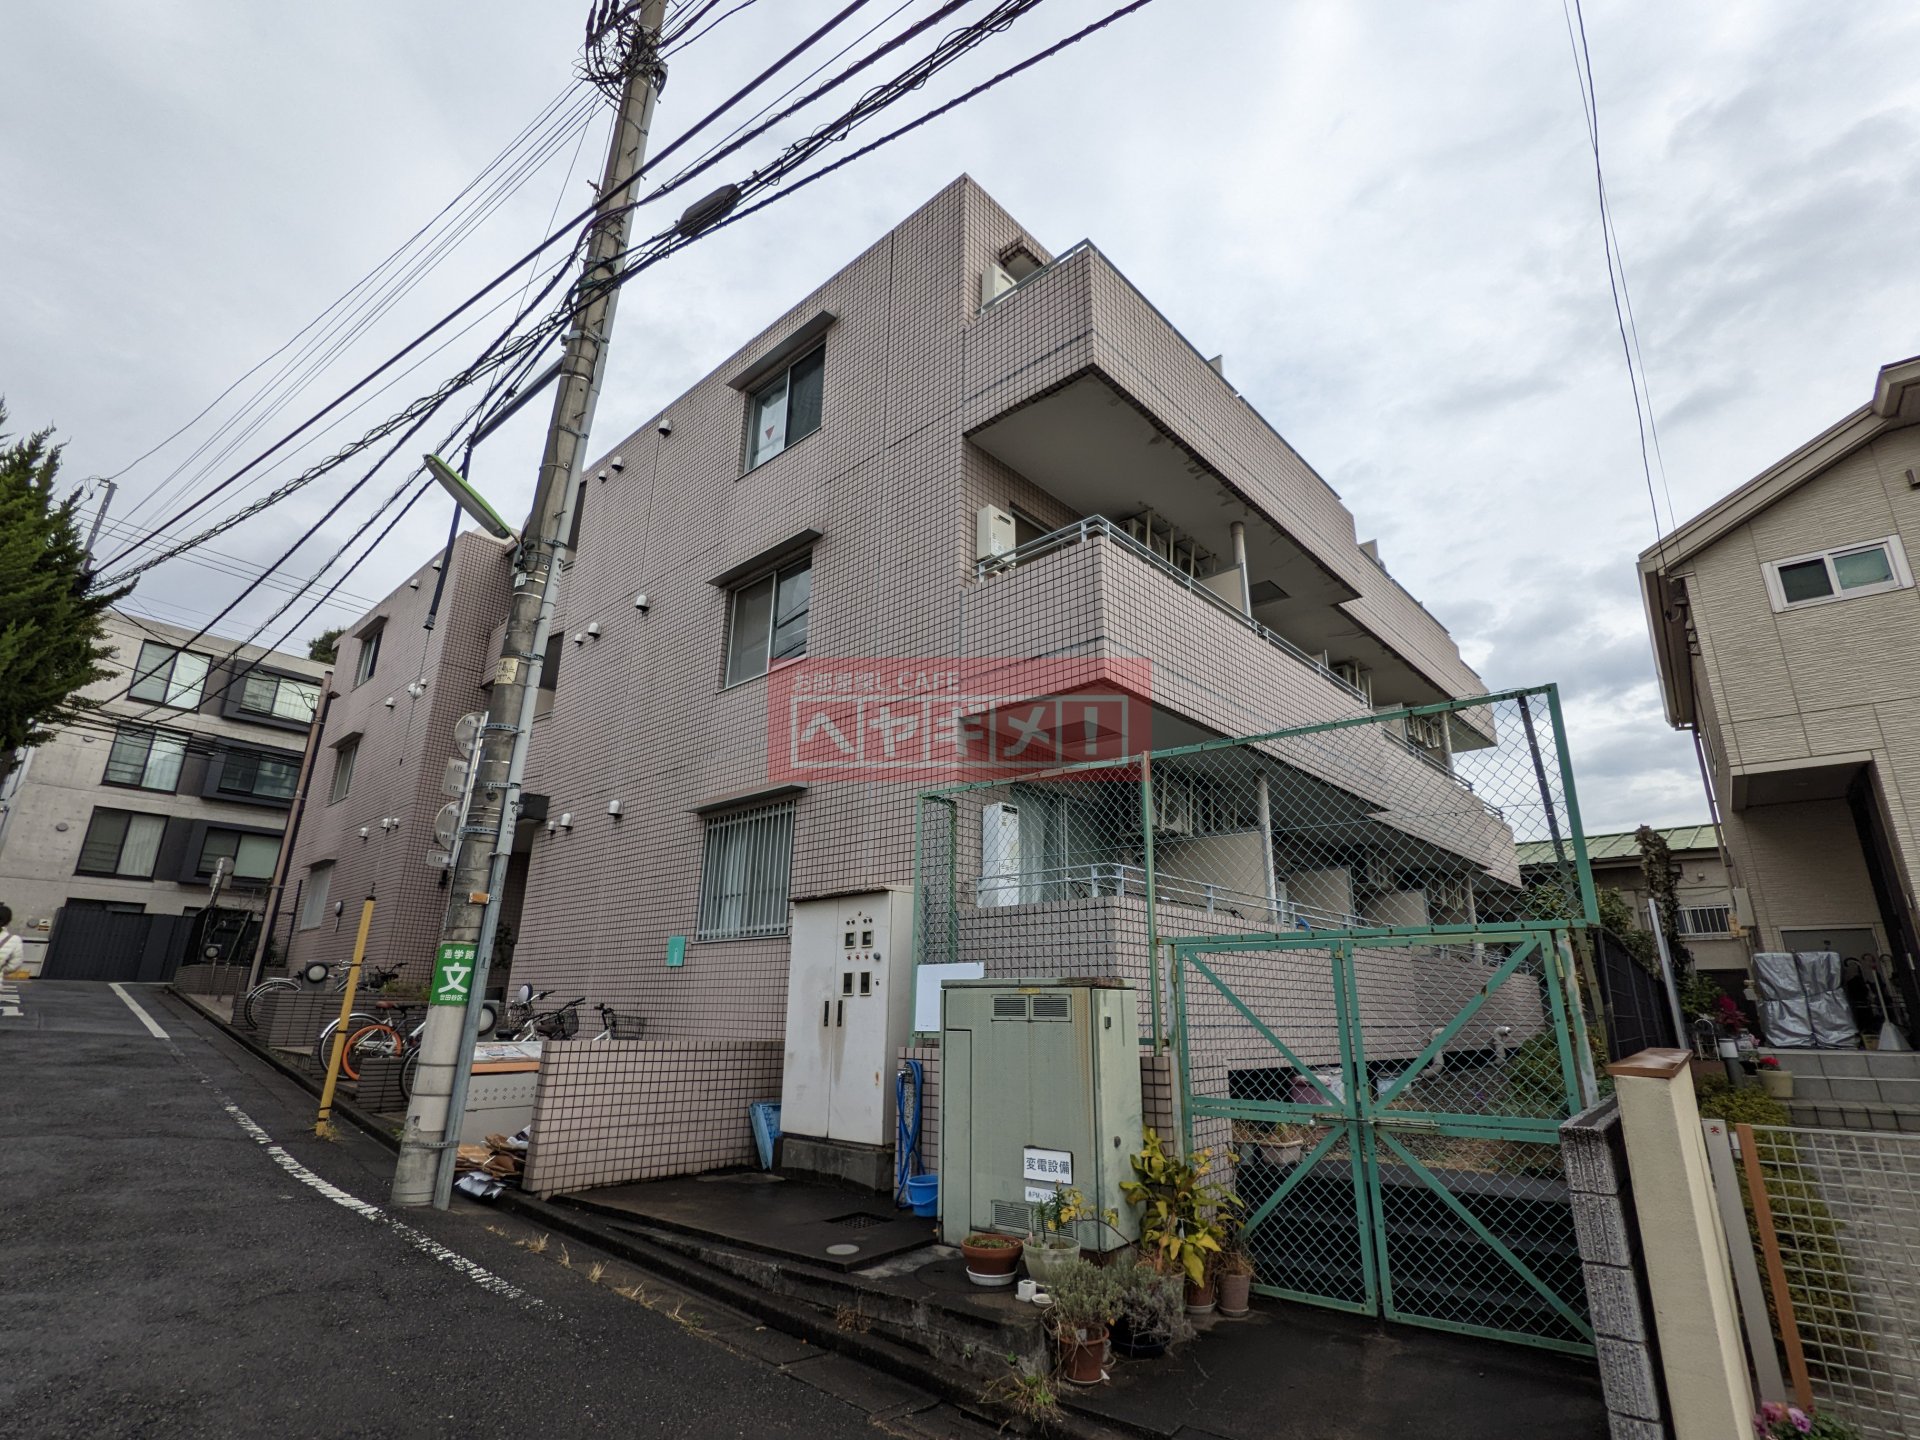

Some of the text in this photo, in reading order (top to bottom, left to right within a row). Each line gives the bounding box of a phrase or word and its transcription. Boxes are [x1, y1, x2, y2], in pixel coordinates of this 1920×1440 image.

[444, 949, 475, 959] 通学路
[438, 962, 471, 993] 文
[1025, 1157, 1070, 1175] 変電設備
